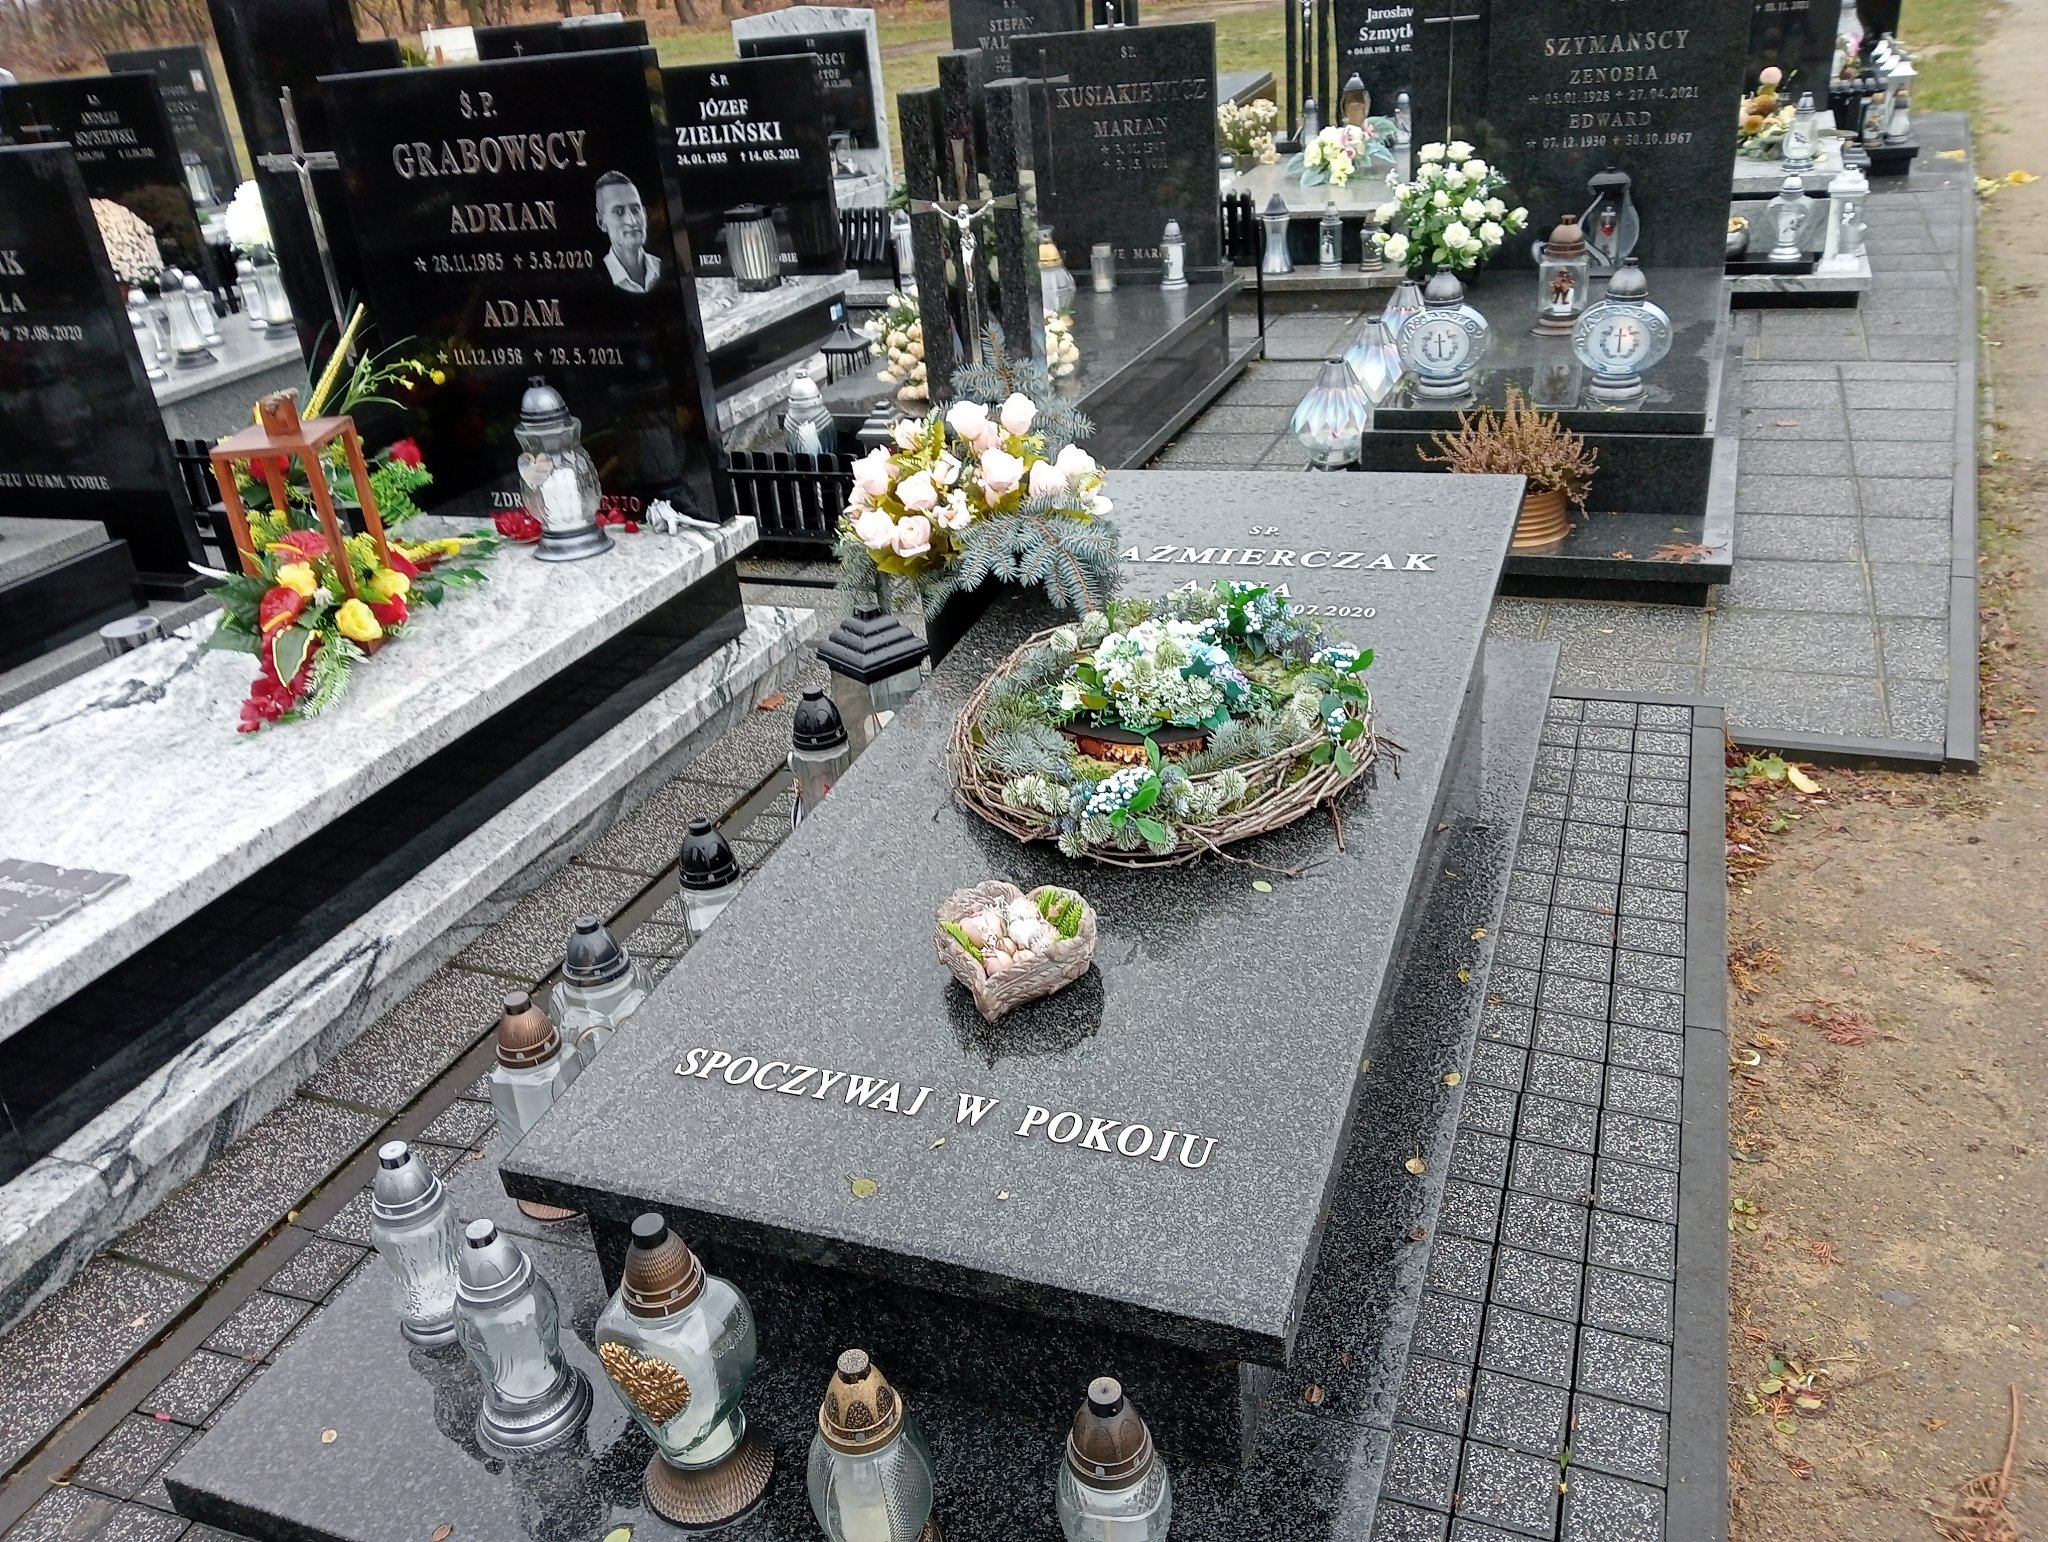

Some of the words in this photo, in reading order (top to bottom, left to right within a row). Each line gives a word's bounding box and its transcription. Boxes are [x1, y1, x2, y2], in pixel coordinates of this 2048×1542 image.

[1359, 23, 1413, 42] Szmytk
[1569, 65, 1659, 85] ZENOBIA
[699, 98, 749, 120] JÓZEF
[1568, 111, 1652, 129] EDWARD
[675, 119, 783, 147] ZIELIŃSKI
[1093, 117, 1168, 138] MARIAN
[392, 129, 588, 180] GRABOWSCY
[450, 200, 560, 234] ADRIAN
[432, 252, 504, 273] 28.11.1985
[529, 249, 594, 271] 5.8.2020
[483, 299, 565, 328] ADAM
[452, 348, 523, 367] 11.12.1958
[1119, 544, 1438, 572] AŹMIERCZAK
[674, 1047, 936, 1118] SPOCZYWAJ
[955, 1092, 1000, 1127] W
[1014, 1105, 1219, 1169] POKOJU
